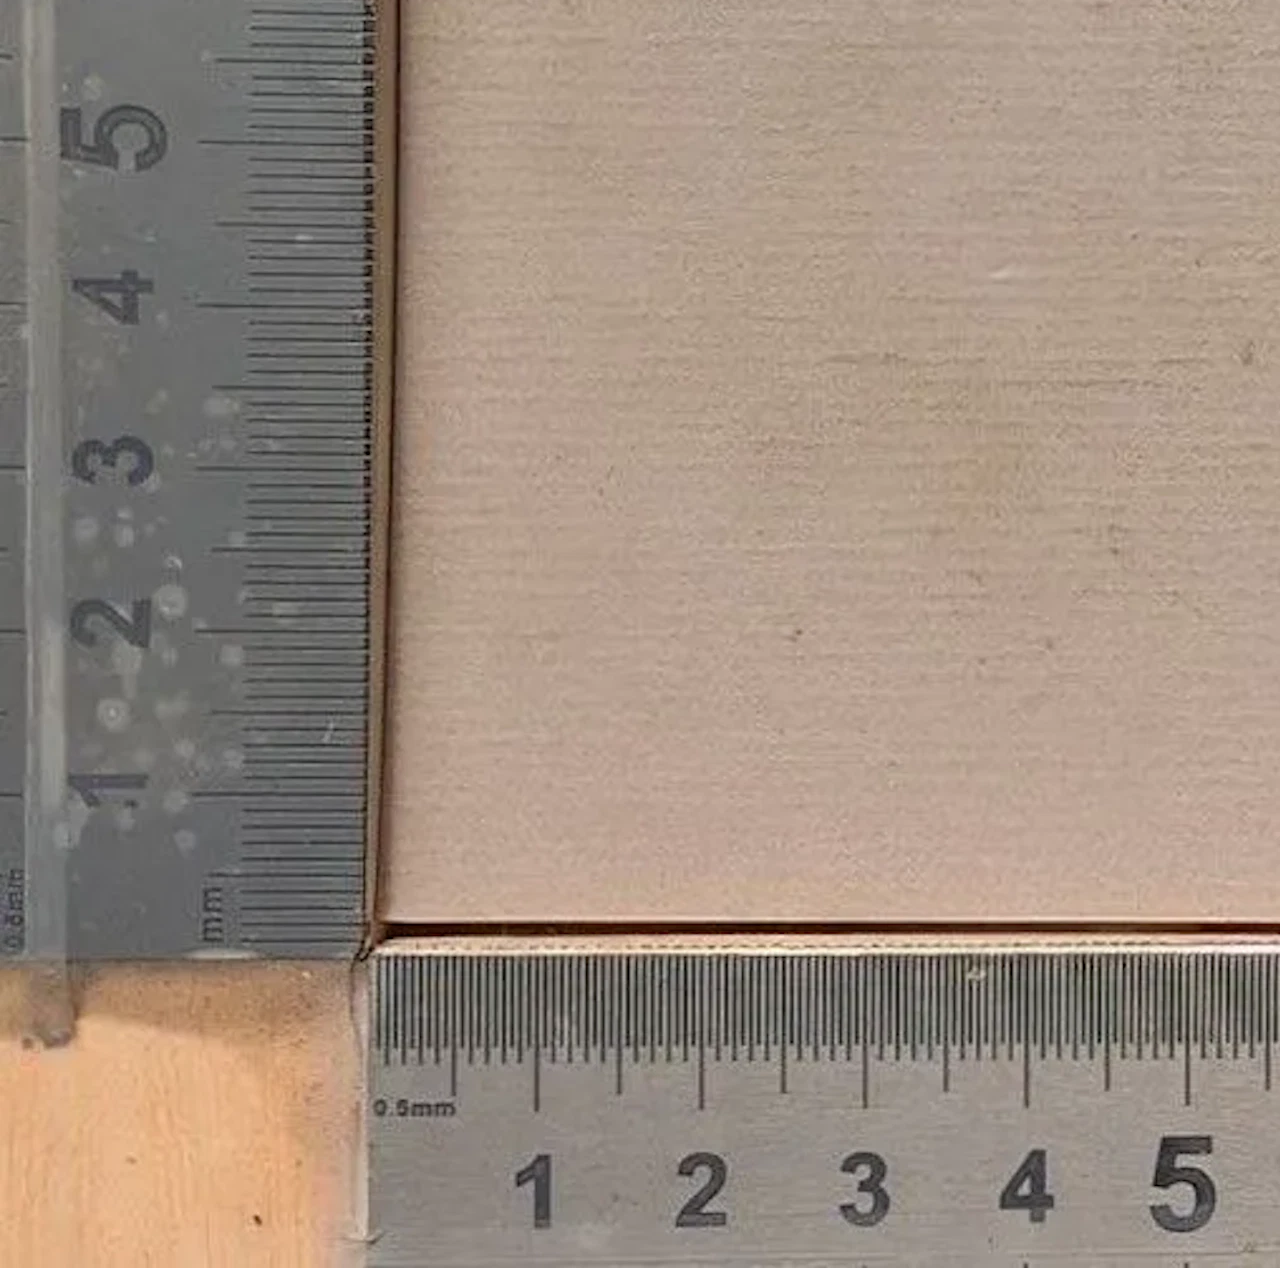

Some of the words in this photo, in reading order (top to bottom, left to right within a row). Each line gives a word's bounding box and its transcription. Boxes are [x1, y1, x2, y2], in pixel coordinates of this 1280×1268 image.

[60, 104, 168, 172] 5
[71, 269, 153, 325] 4
[71, 435, 154, 485] 3
[69, 598, 151, 649] 2
[67, 773, 148, 807] 1
[373, 1099, 456, 1118] 0.5mm
[514, 1155, 552, 1229] 1
[675, 1152, 728, 1228] 2
[839, 1151, 891, 1227] 3
[999, 1149, 1055, 1223] 4
[1149, 1135, 1217, 1232] 5
